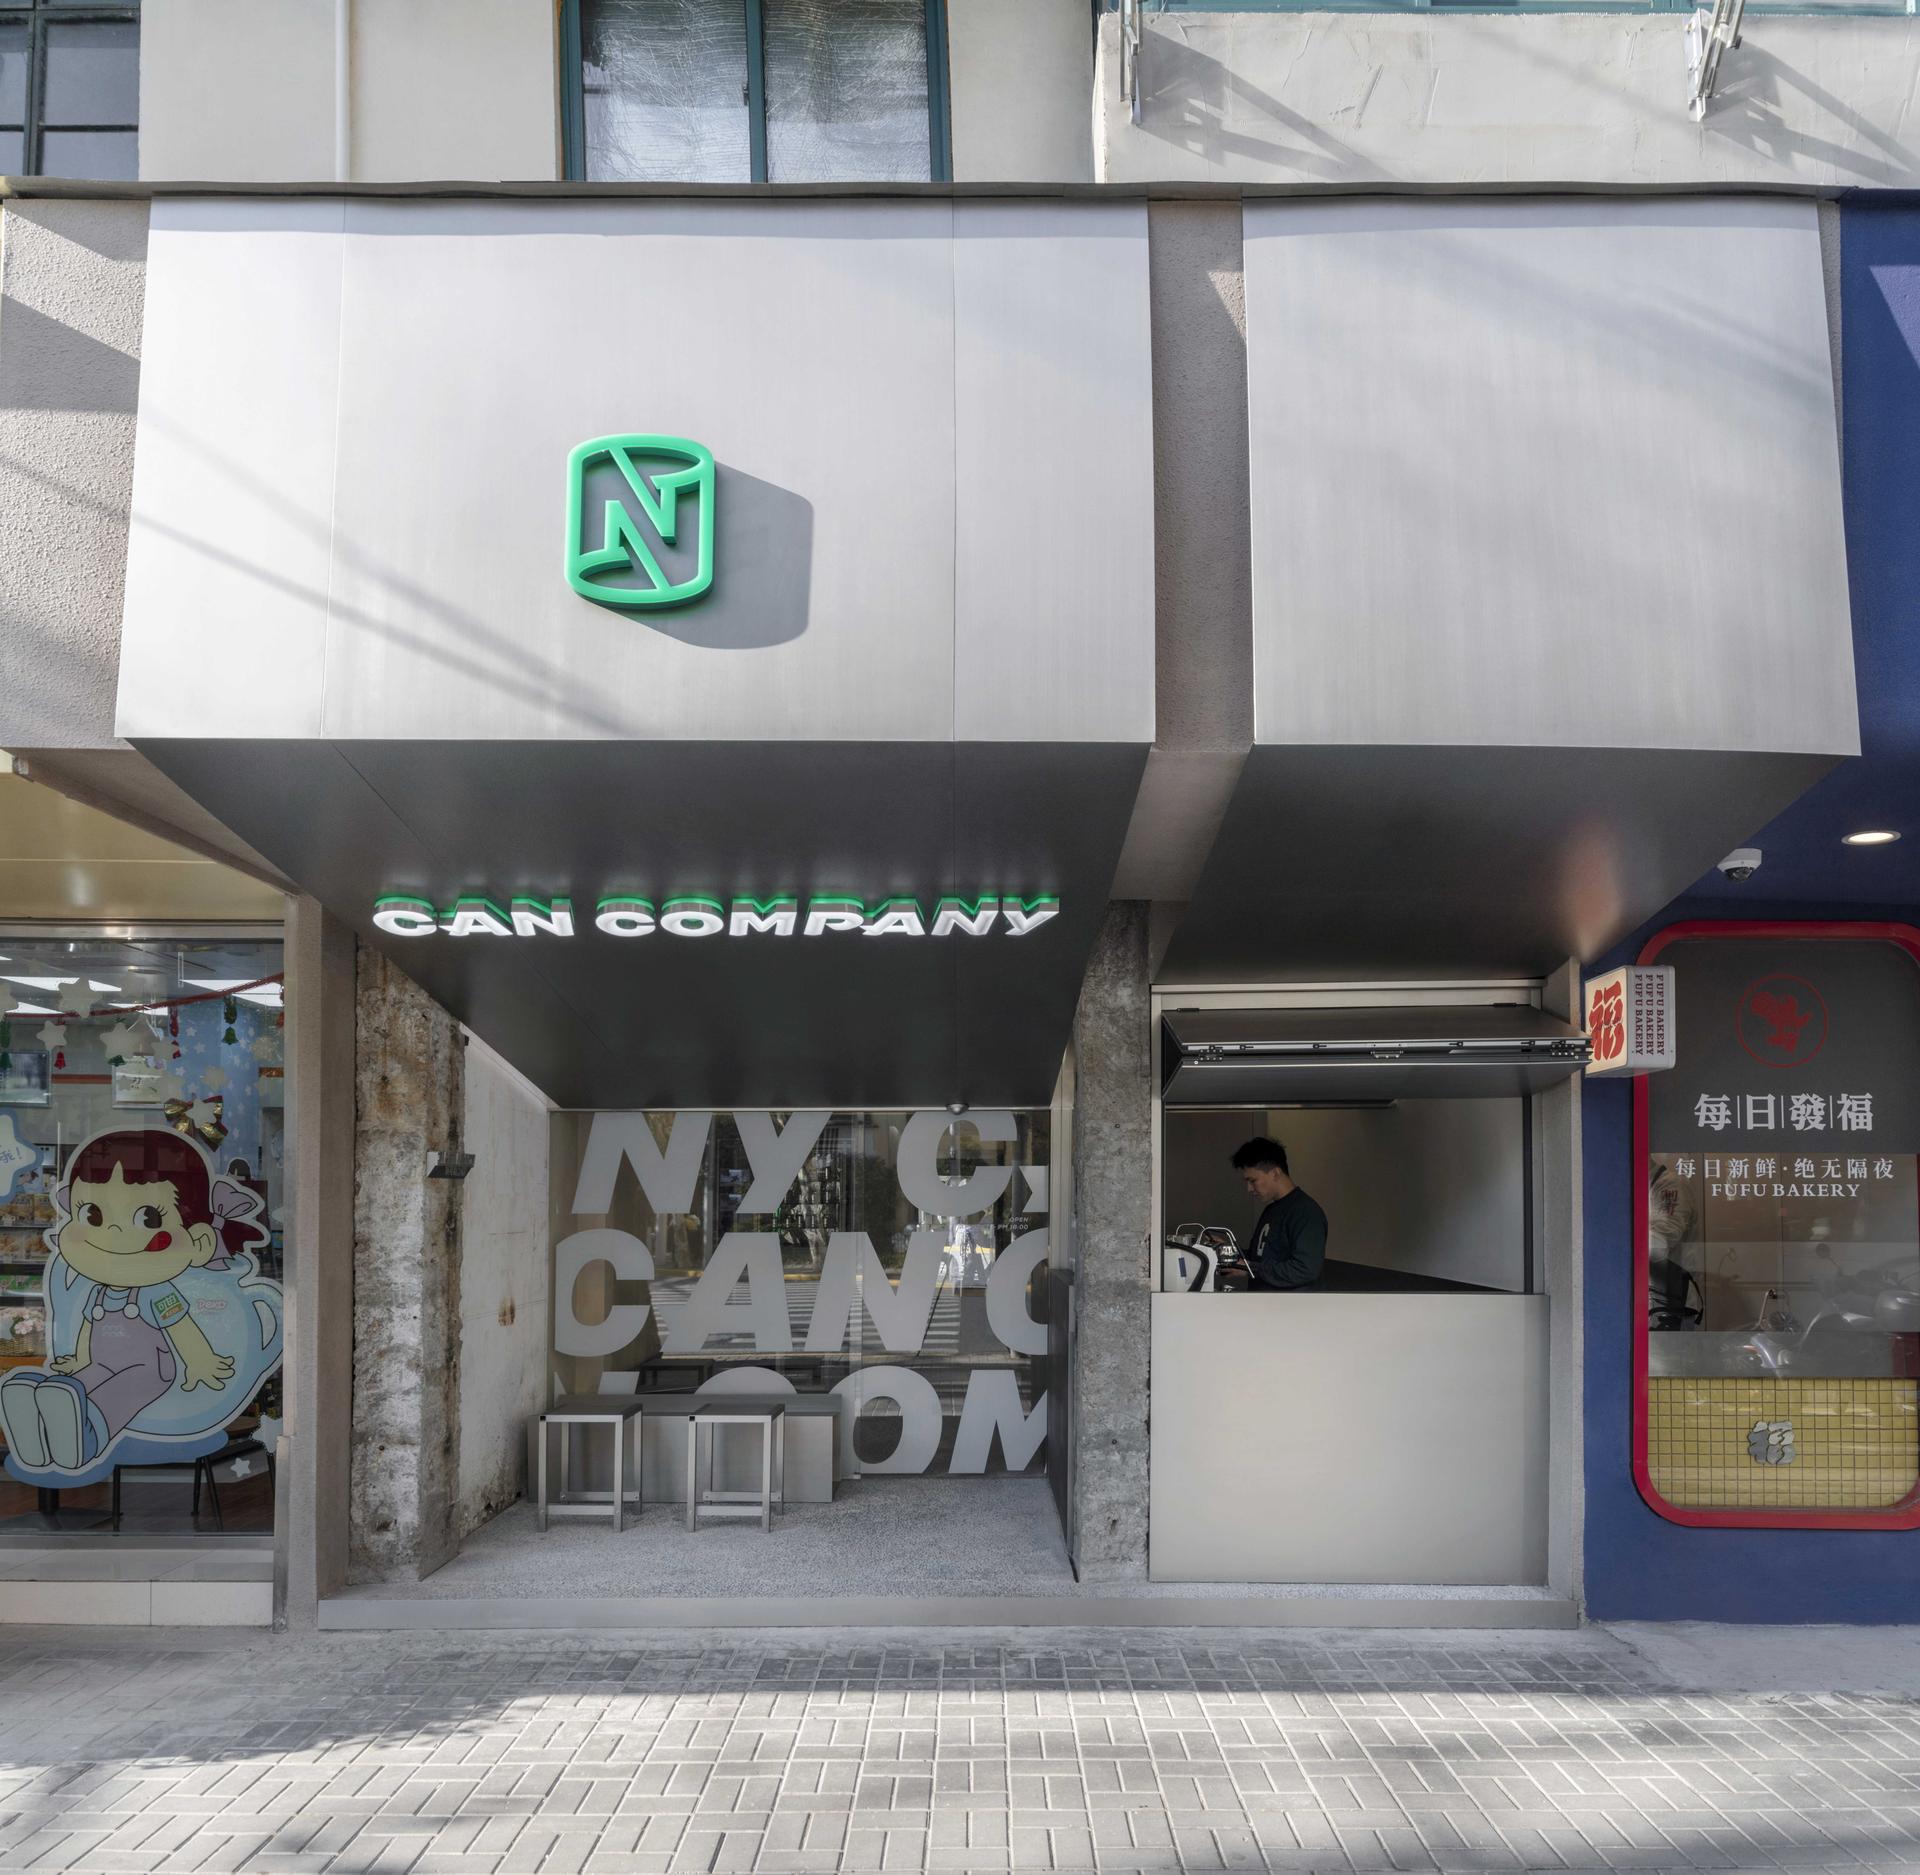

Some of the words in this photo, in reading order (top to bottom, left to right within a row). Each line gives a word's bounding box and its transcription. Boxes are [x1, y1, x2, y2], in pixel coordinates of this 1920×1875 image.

[371, 903, 575, 937] CAN
[594, 903, 1061, 937] COMPANY
[1635, 974, 1644, 1006] FUFU
[1645, 974, 1654, 1006] FUFU
[1656, 974, 1665, 1006] FUFU
[1635, 1009, 1644, 1055] BAKERY
[1645, 1009, 1654, 1055] BAKERY
[1656, 1009, 1665, 1055] BAKERY
[1711, 1183, 1766, 1197] FUFU
[1772, 1183, 1860, 1197] BAKERY
[554, 1228, 946, 1356] CAN
